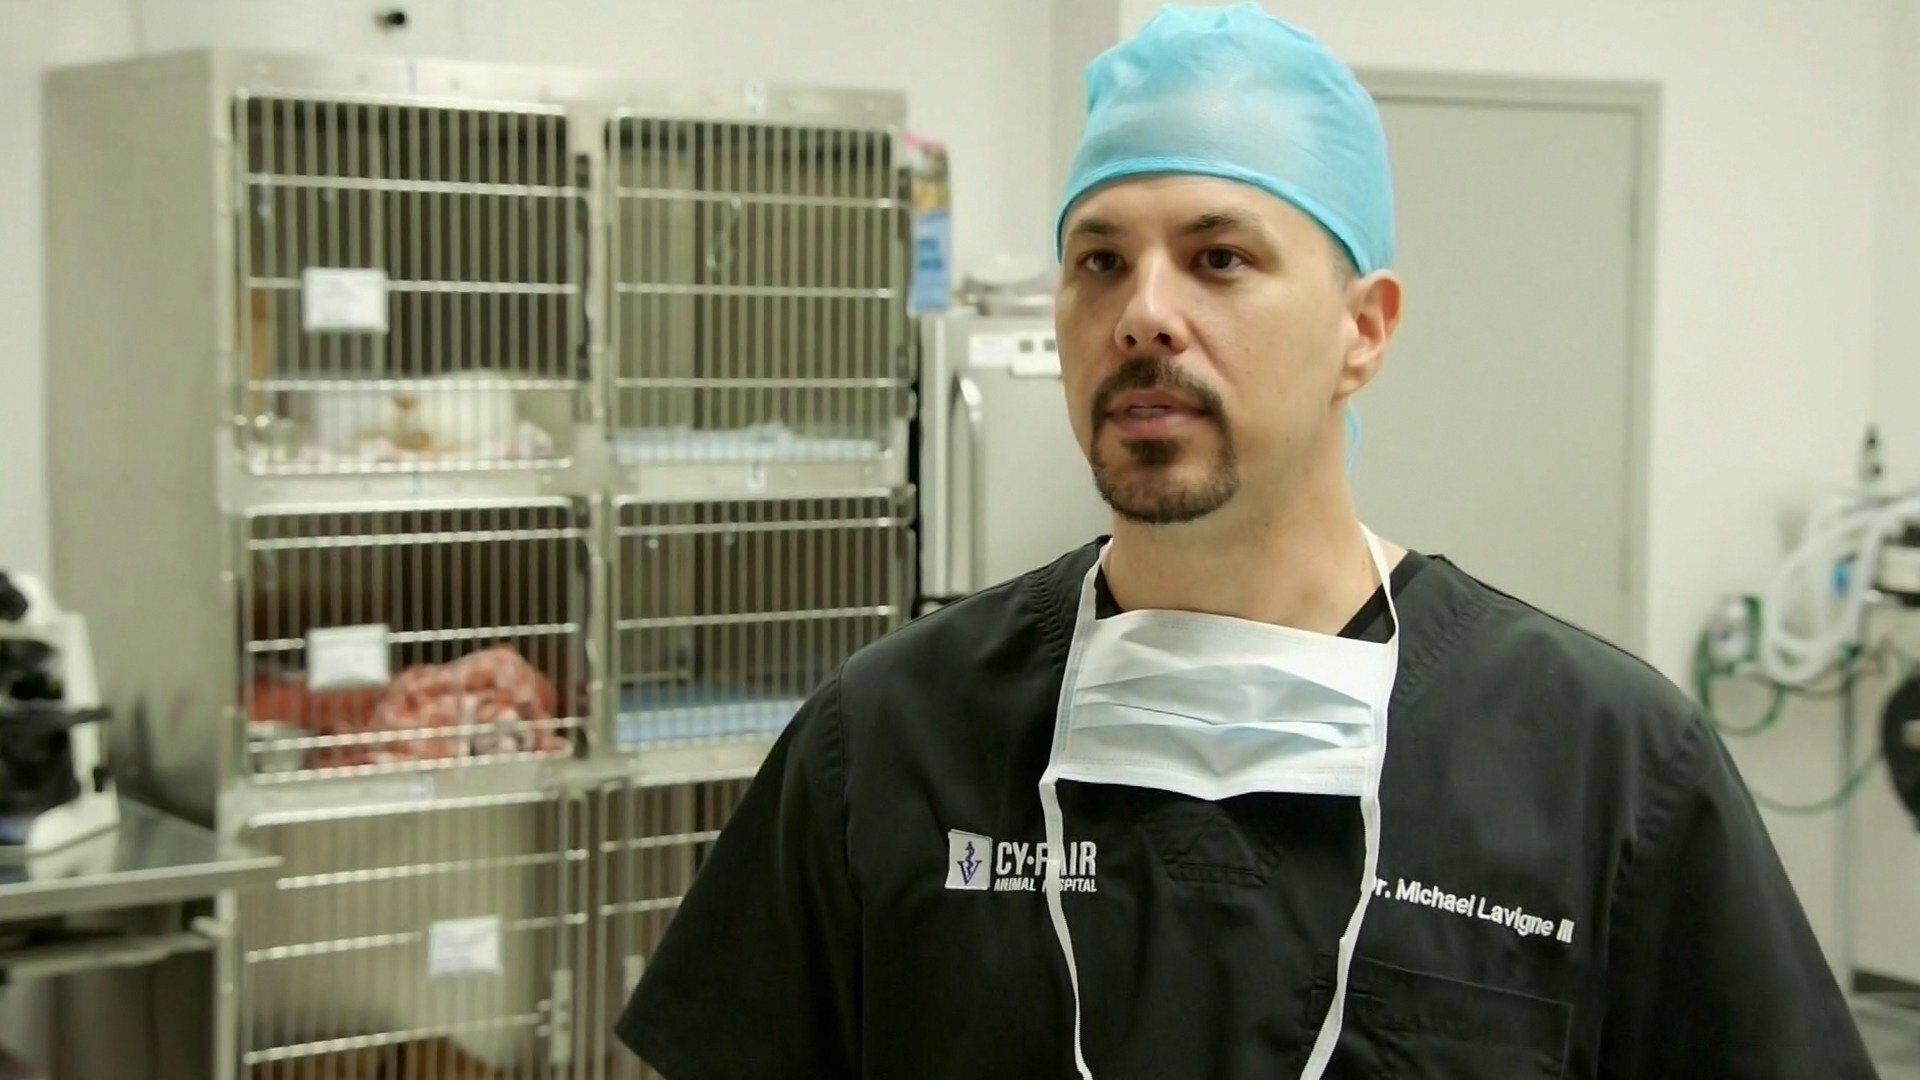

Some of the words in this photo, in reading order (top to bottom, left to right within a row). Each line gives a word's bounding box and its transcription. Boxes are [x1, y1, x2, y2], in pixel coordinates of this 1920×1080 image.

[993, 877, 1036, 892] ANIMAL
[1042, 878, 1097, 893] SPITAL
[1368, 878, 1391, 898] r.
[1395, 878, 1476, 917] Michael
[1477, 896, 1554, 937] Lavigne
[1556, 918, 1575, 943] III
